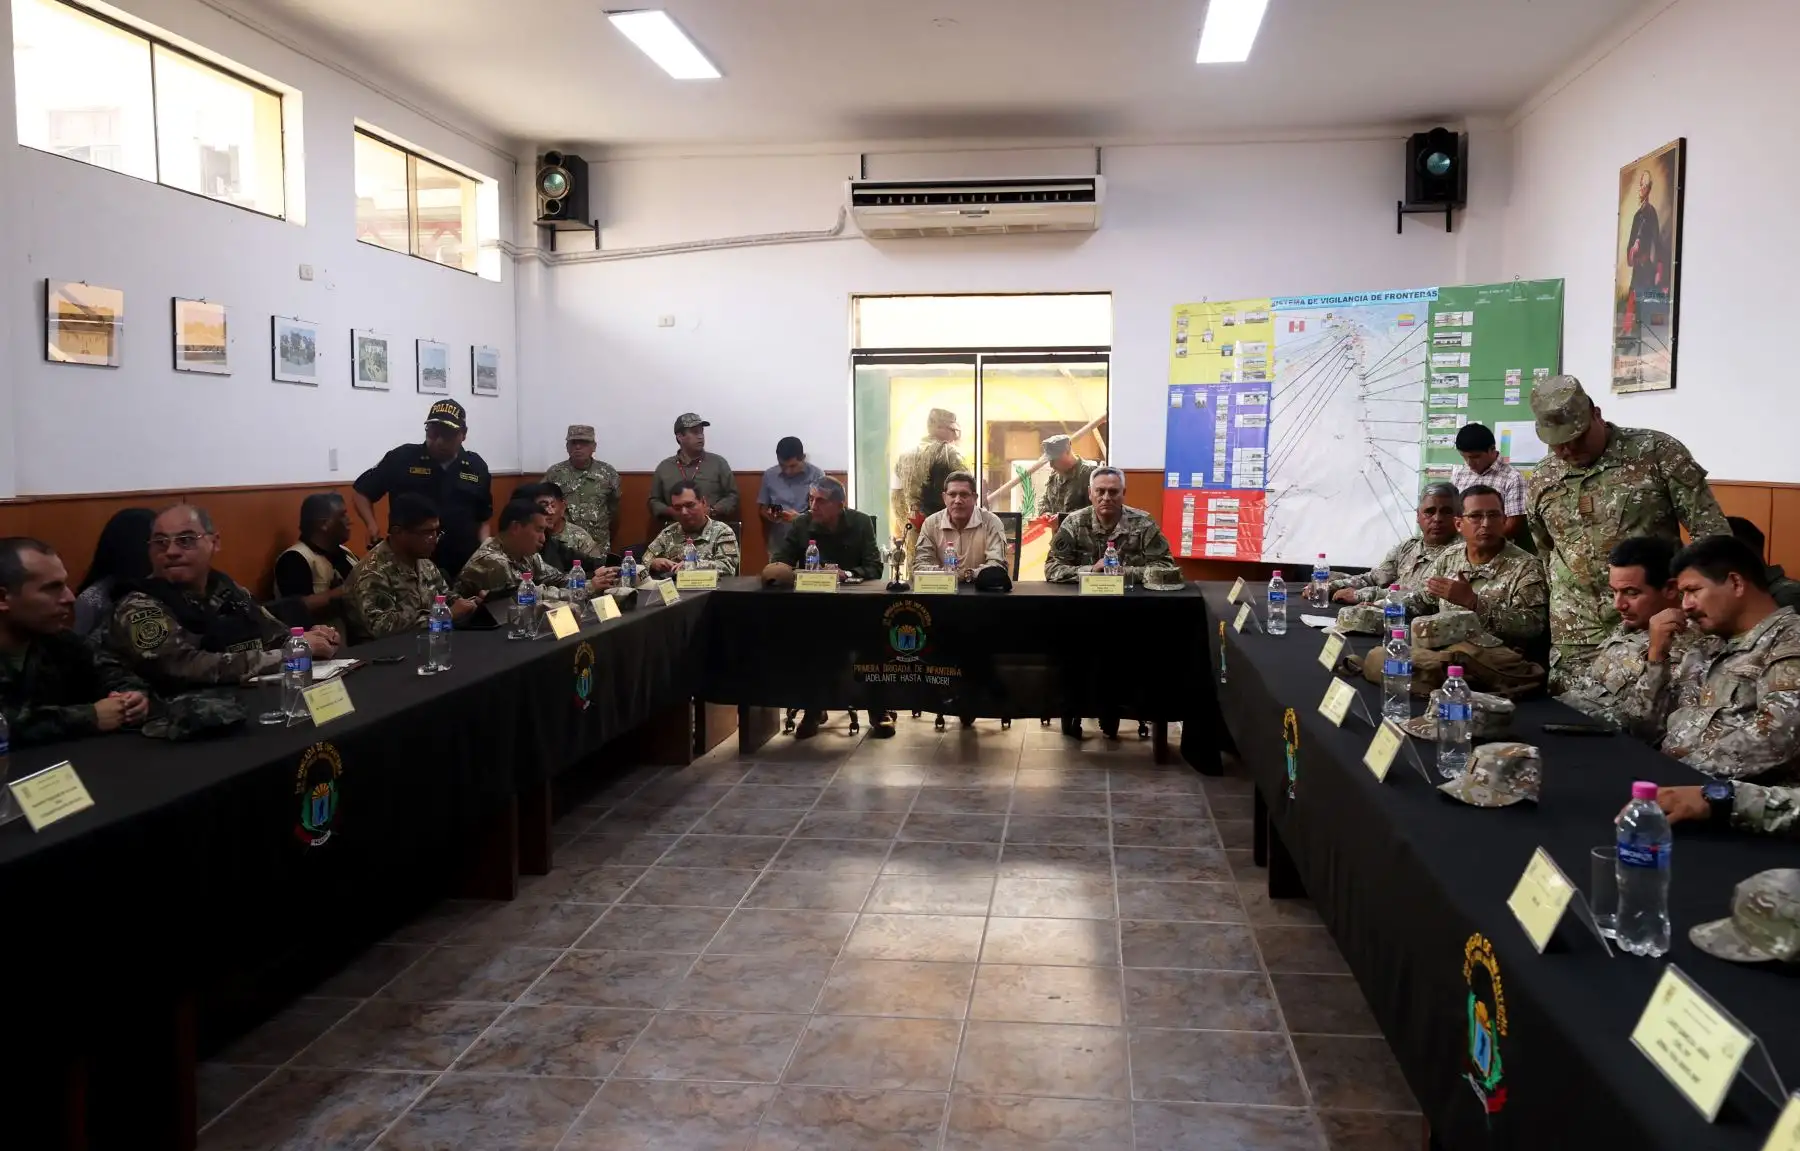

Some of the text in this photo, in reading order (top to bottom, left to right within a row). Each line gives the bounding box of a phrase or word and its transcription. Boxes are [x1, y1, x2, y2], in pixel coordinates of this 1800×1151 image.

[1321, 295, 1368, 304] VIGILANCIA
[1384, 290, 1438, 300] FRONTERAS
[432, 403, 460, 419] POLICIA
[853, 664, 879, 673] PRIMERA
[883, 664, 912, 673] BRIGADA
[914, 664, 922, 673] DE
[900, 674, 922, 682] HASTA
